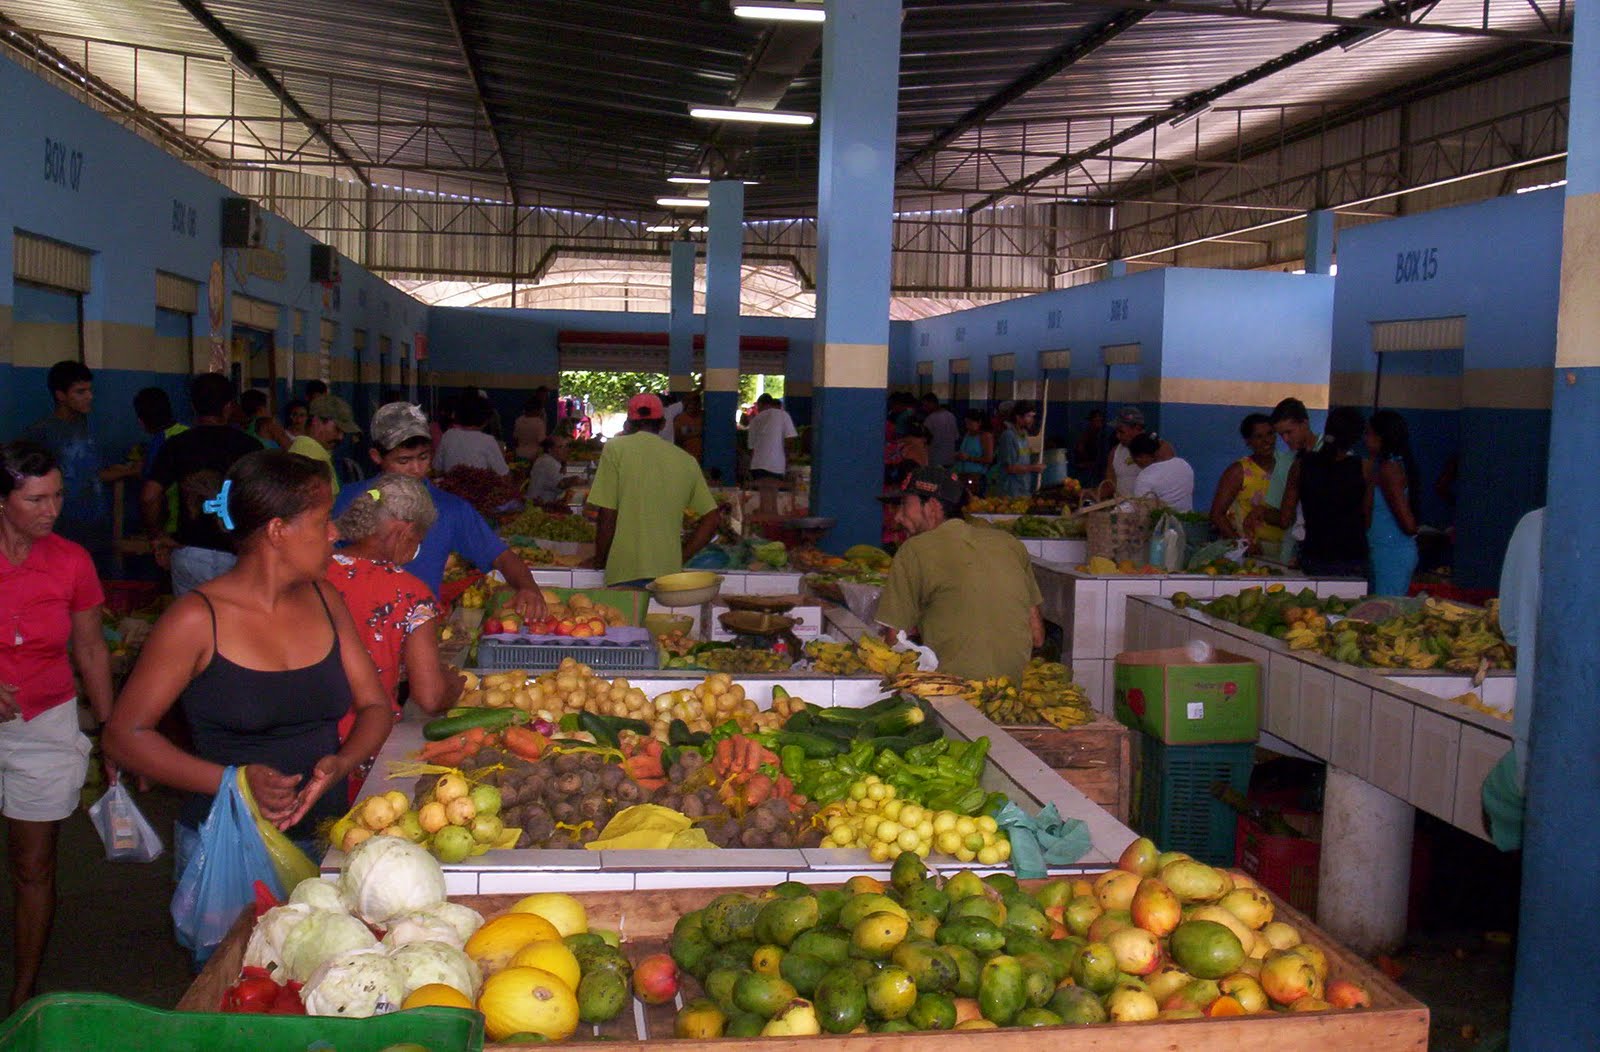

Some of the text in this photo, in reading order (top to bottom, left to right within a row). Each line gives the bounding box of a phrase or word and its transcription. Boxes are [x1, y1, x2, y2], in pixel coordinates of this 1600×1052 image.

[44, 137, 83, 192] BOX 07
[1395, 248, 1438, 284] BOX 15
